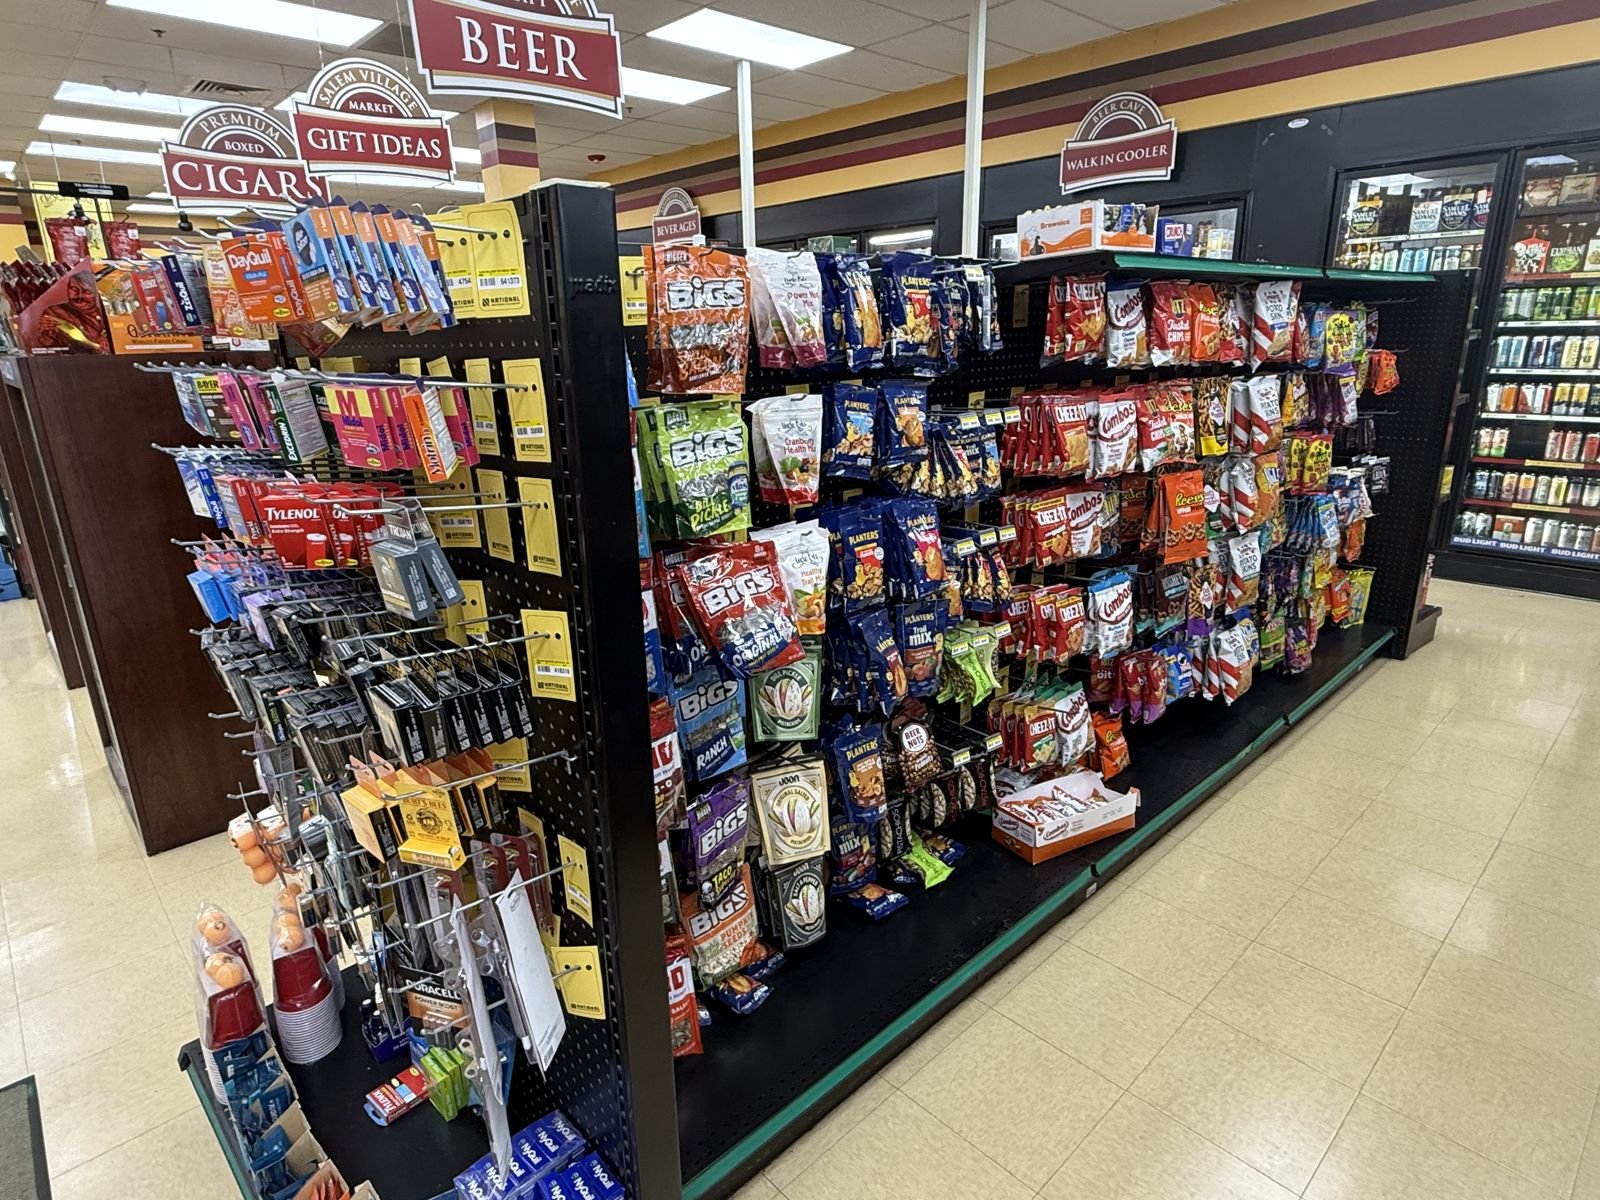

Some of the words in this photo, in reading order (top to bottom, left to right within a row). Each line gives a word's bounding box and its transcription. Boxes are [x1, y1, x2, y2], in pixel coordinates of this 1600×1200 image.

[456, 16, 588, 81] BEER
[319, 70, 357, 105] SALEM
[358, 69, 419, 111] VILLAGE
[349, 100, 394, 115] MARKET
[1092, 102, 1117, 124] BEER
[1119, 100, 1147, 116] CAVE
[199, 112, 281, 142] PREMIUM
[223, 140, 265, 155] BOXED
[306, 127, 366, 151] GIFT
[372, 134, 442, 159] IDEAS
[1066, 159, 1099, 171] WALK
[1100, 154, 1114, 167] IN
[1116, 144, 1168, 163] COOLER
[171, 161, 324, 202] CIGARS
[656, 220, 697, 237] BEVERAGES
[227, 248, 273, 270] DayQuil
[569, 275, 617, 295] madix
[901, 276, 932, 287] PLANTERS
[285, 279, 305, 317] DayQuil
[490, 296, 521, 305] NATIONAL
[197, 379, 219, 390] BAYER
[844, 399, 870, 411] PLANTERS
[1102, 402, 1135, 434] Combos
[279, 421, 298, 461] EXCEDRIN
[422, 436, 440, 475] Motrin
[264, 507, 321, 521] TYLENOL
[389, 523, 413, 540] TROJAN
[849, 530, 880, 546] PLANTERS
[1453, 536, 1472, 544] BUD
[1471, 538, 1498, 547] LIGHT
[1500, 542, 1519, 550] BUD
[1519, 545, 1546, 553] LIGHT
[1551, 548, 1572, 556] BUD
[1571, 551, 1600, 560] LIGHT
[904, 613, 935, 625] PLANTERS
[908, 631, 933, 646] mix
[912, 626, 927, 635] Trail
[732, 634, 782, 667] ORIGINAL
[770, 671, 782, 682] DILL
[782, 669, 802, 681] PICKLE
[904, 728, 921, 740] BEER
[1030, 716, 1056, 737] CHEEZ-IT
[846, 738, 879, 761] PLANTERS
[907, 736, 925, 749] NUTS
[696, 736, 728, 771] RANCH
[775, 788, 794, 807] ORIGINAL
[794, 788, 811, 802] SALTED
[838, 836, 862, 854] mix
[405, 979, 462, 1000] DURACELL
[414, 995, 438, 1006] POWER
[438, 1000, 458, 1011] BOOST
[555, 1119, 577, 1142] NyQuil
[537, 1130, 560, 1153] NyQuil
[521, 1142, 543, 1166] NyQuil
[592, 1164, 615, 1190] NyQuil
